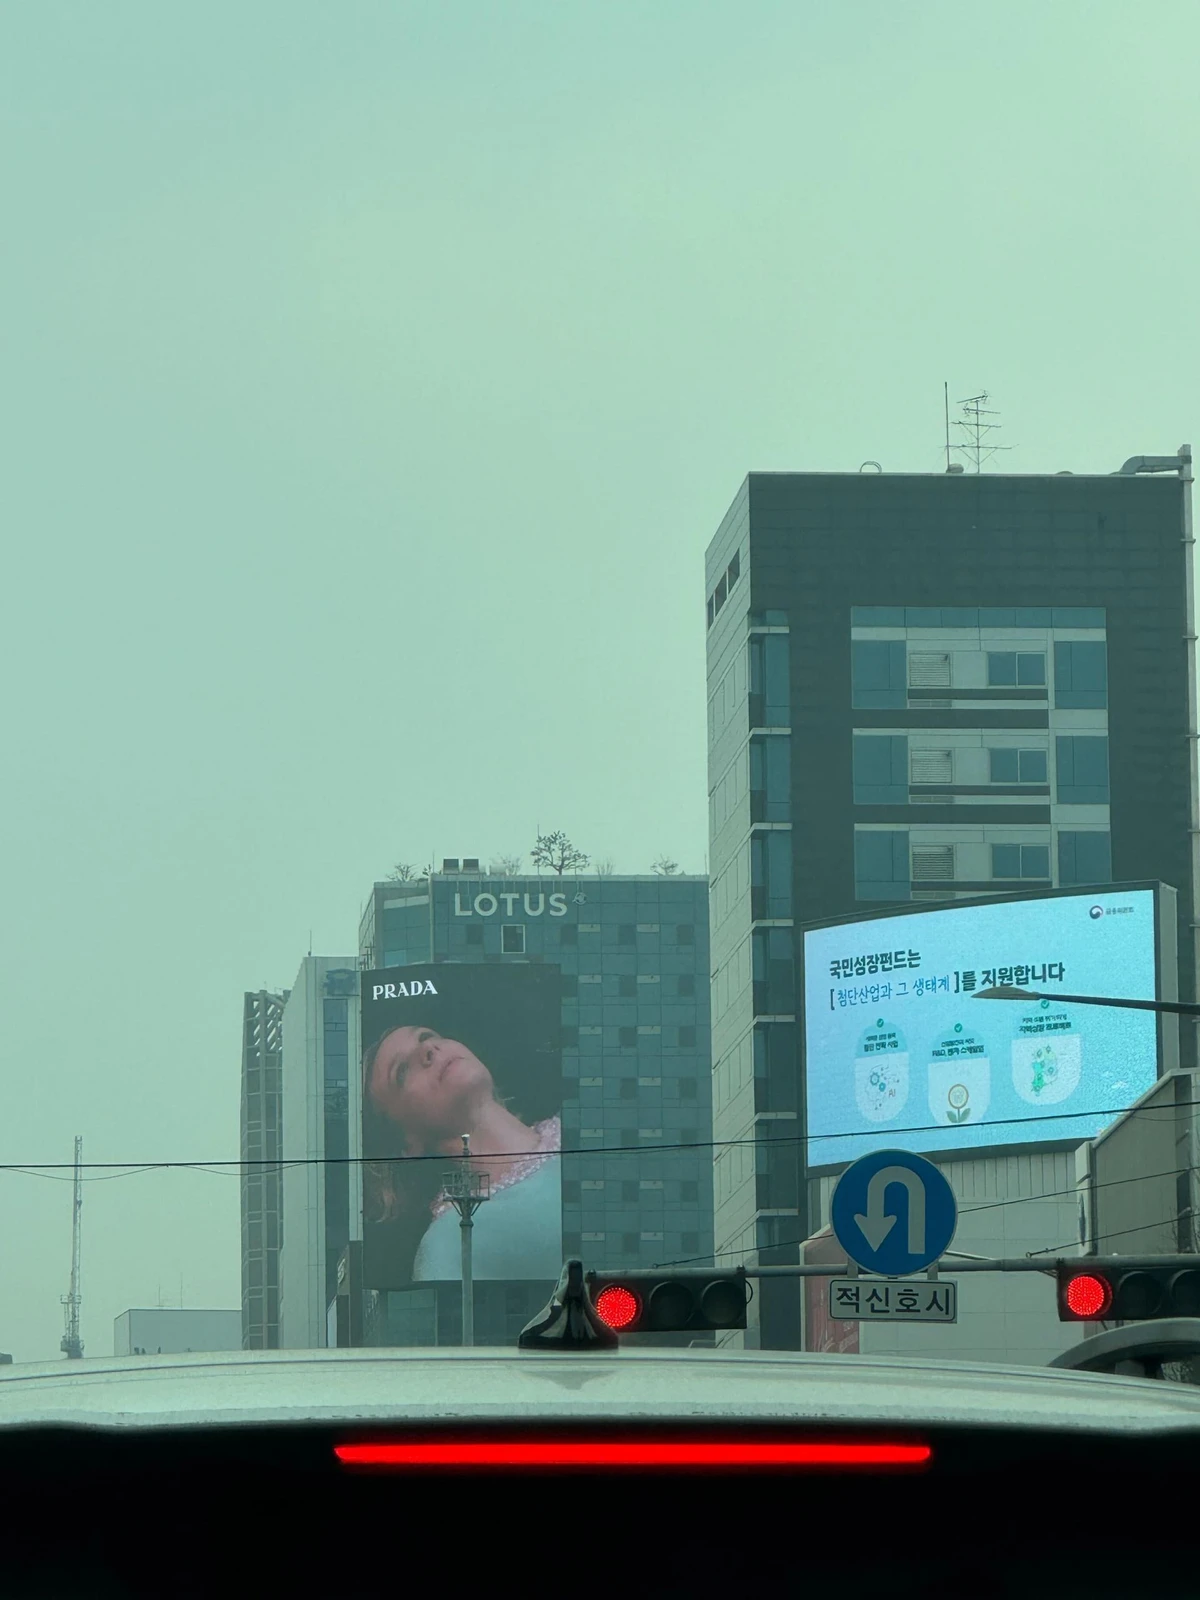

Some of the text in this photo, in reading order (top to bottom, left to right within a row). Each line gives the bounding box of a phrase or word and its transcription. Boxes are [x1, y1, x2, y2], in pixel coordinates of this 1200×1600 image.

[454, 892, 568, 917] LOTUS
[829, 949, 922, 979] 국민성장펀드는
[896, 982, 909, 996] 그
[981, 961, 1065, 987] 지원합니다
[372, 980, 438, 1000] PRADA
[836, 1286, 950, 1315] 적신호시
